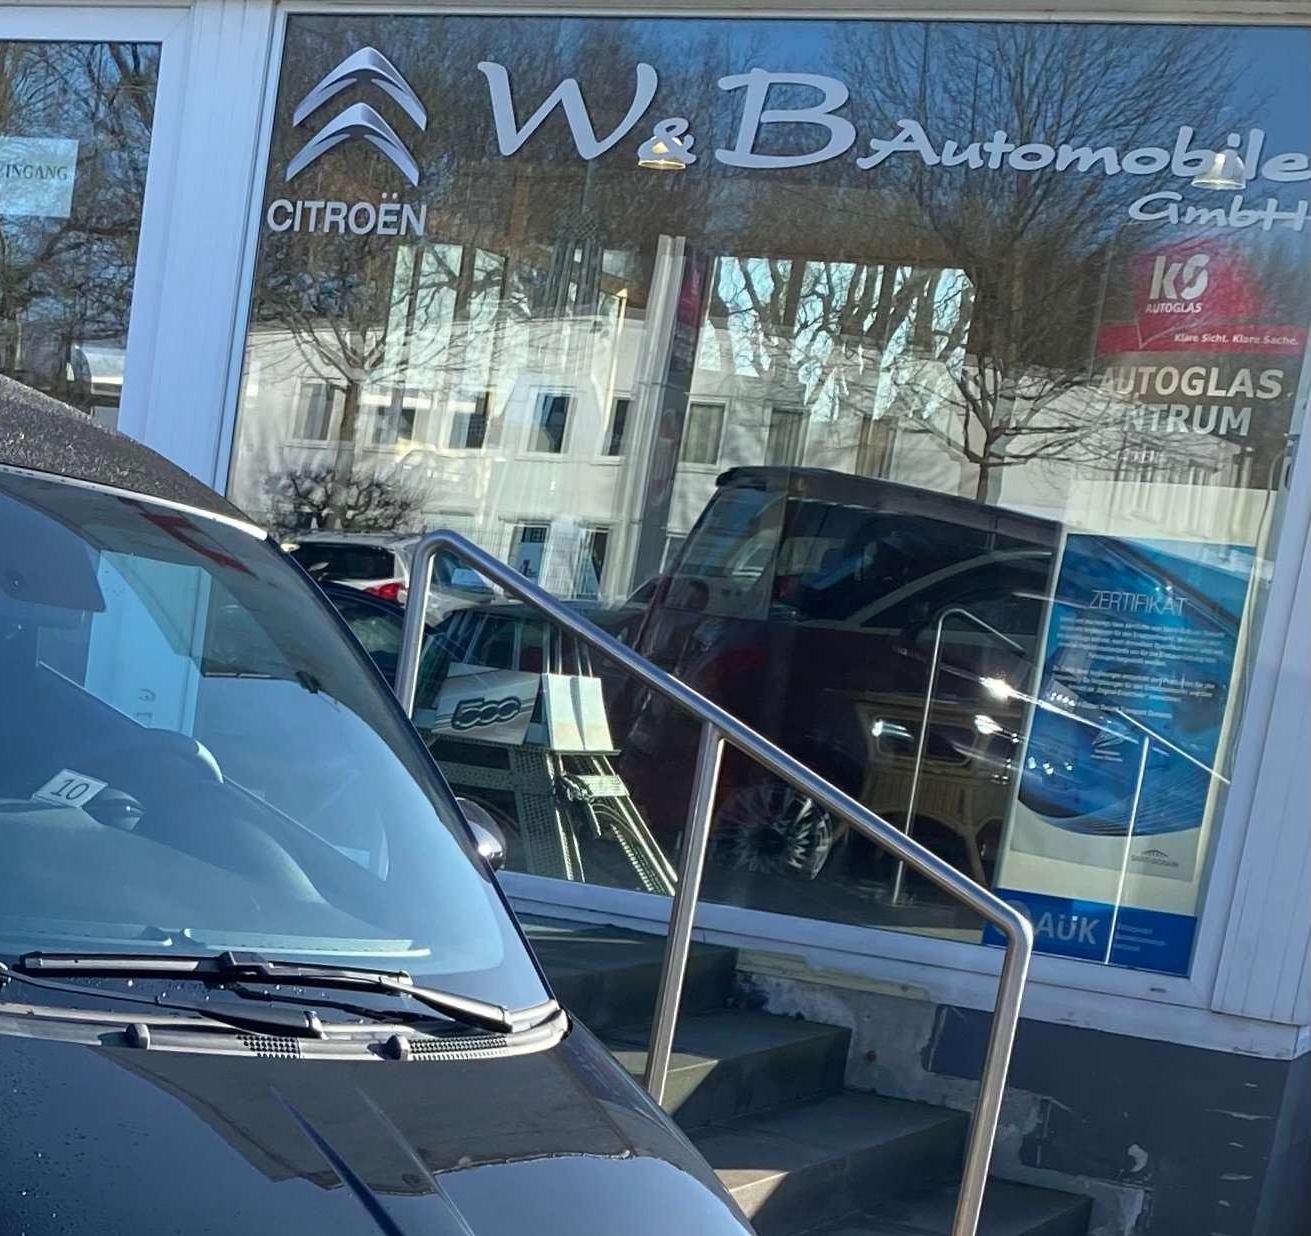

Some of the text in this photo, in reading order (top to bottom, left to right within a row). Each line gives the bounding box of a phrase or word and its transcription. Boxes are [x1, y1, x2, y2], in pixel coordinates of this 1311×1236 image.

[477, 61, 659, 161] W
[636, 117, 697, 170] &
[715, 67, 857, 169] B
[266, 193, 427, 237] CITROËN
[1127, 191, 1311, 231] GmbH
[1145, 302, 1203, 314] AUTOGLAS
[1174, 333, 1299, 346] Klare Sicht. Klare Sache.
[1100, 366, 1284, 400] AUTOGLAS
[1089, 590, 1187, 617] ZERTIFIKAT
[450, 696, 522, 731] 500
[49, 778, 90, 801] 10
